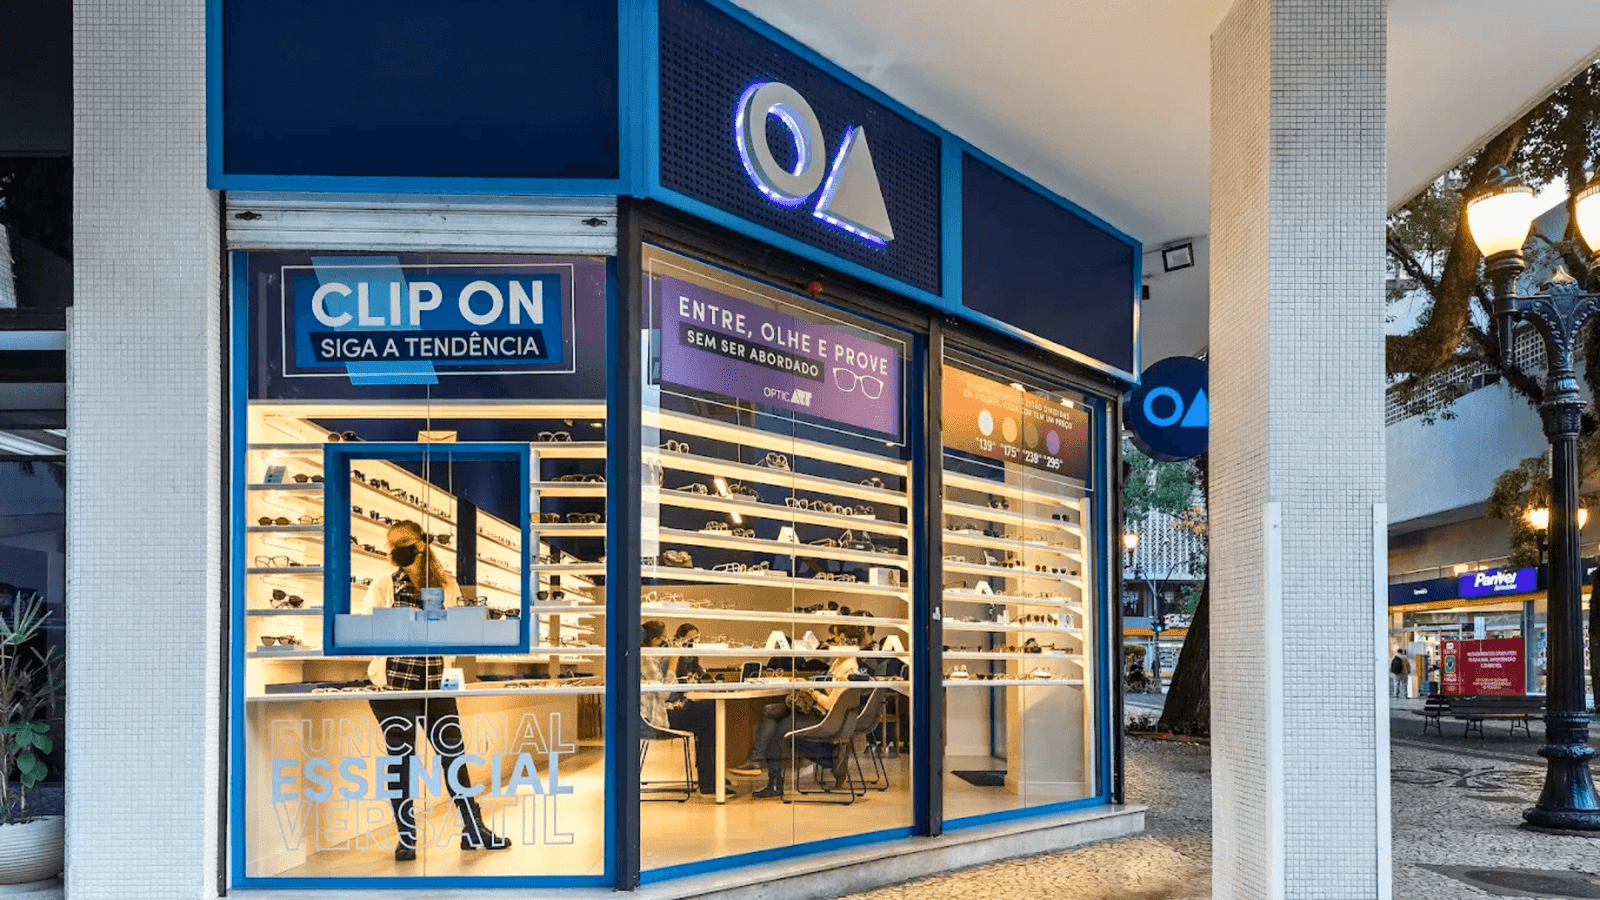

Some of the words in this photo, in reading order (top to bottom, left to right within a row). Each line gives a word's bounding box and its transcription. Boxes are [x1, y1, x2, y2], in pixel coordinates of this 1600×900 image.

[311, 281, 443, 327] CLIP
[458, 279, 544, 326] ON
[320, 337, 378, 358] SIGA
[382, 337, 400, 357] A
[404, 331, 540, 357] TENDÊNCIA
[678, 295, 753, 339] ENTRE,
[760, 322, 811, 353] OLHE
[818, 339, 828, 358] E
[834, 344, 888, 376] PROVE
[687, 330, 717, 350] SEM
[721, 339, 746, 357] SER
[749, 347, 819, 377] ABORDADO
[271, 712, 575, 759] FUNCIONAL
[271, 752, 575, 803] ESSENCIAL
